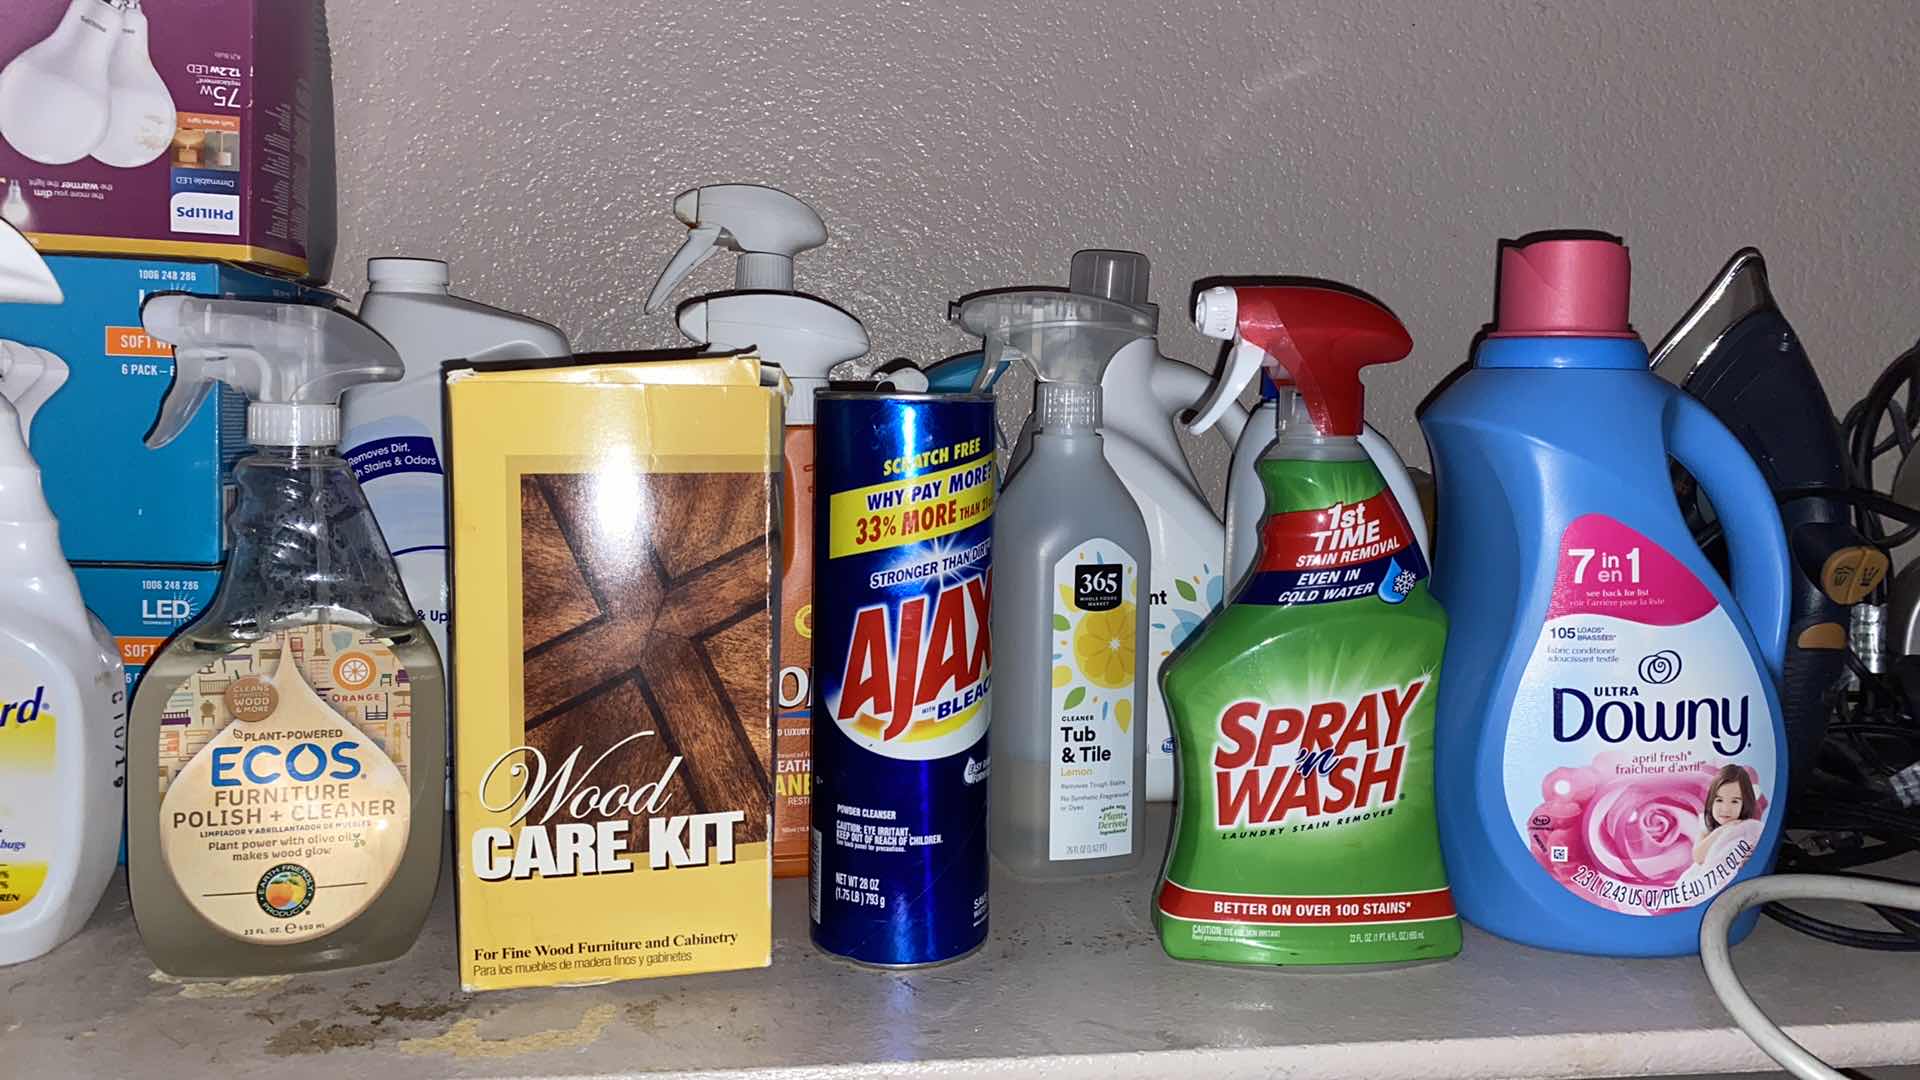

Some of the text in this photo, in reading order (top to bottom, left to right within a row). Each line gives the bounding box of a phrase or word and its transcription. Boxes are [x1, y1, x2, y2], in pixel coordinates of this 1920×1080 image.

[186, 64, 241, 77] 12.2w LED
[200, 85, 241, 108] 75w
[61, 181, 99, 190] warmer
[175, 176, 193, 186] LED
[33, 189, 53, 199] dim
[176, 206, 234, 221] PHILIPS
[139, 269, 160, 280] 1006
[162, 270, 178, 281] 248
[120, 334, 152, 349] SOFT
[130, 364, 158, 376] PACK
[347, 446, 390, 468] Removes
[363, 458, 393, 475] Stains
[394, 456, 403, 466] &
[404, 454, 437, 467] Odors
[883, 437, 981, 477] SCRATCH FREE
[867, 461, 992, 511] WHY PAY MORE?
[855, 499, 980, 545] 33% MORE THAN
[1328, 503, 1366, 530] 1st
[1310, 519, 1380, 552] TIME
[1296, 536, 1400, 568] STAIN REMOVAL
[870, 552, 971, 588] STRONGER THAN
[1568, 547, 1640, 584] 7 in 1
[141, 580, 162, 590] 1006
[164, 580, 180, 590] 248
[1080, 571, 1118, 594] 365
[1297, 568, 1362, 586] EVEN IN
[1598, 570, 1623, 583] en
[1278, 582, 1375, 603] COLD WATER
[1602, 589, 1622, 597] back
[1624, 589, 1636, 597] for
[142, 599, 191, 619] LED
[416, 609, 426, 621] &
[1550, 627, 1576, 639] 105
[123, 644, 158, 658] SOFT
[837, 567, 993, 742] AJAX
[1572, 646, 1617, 655] conditioner
[1596, 655, 1618, 663] textile
[332, 692, 381, 703] ORANGE
[1594, 686, 1639, 697] ULTRA
[233, 697, 270, 706] WOOD
[1061, 714, 1095, 722] CLEANER
[1215, 680, 1425, 769] SPRAY
[1552, 687, 1750, 757] Downy
[244, 729, 343, 742] PLANT-POWERED
[1060, 726, 1097, 743] Tub
[1061, 745, 1112, 763] & Tile
[1632, 752, 1657, 764] april
[211, 741, 362, 787] ECOS
[1060, 767, 1094, 777] Lemon
[478, 730, 683, 828] Wood
[1216, 745, 1406, 826] WASH
[215, 783, 350, 807] FURNITURE
[173, 799, 396, 828] POLISH + CLEANER
[836, 803, 897, 820] POWDER CLEANSER
[864, 825, 876, 835] EYE
[1222, 808, 1394, 840] LAUNDRY STAIN REMOVER
[200, 828, 247, 839] LIMPIADOR
[208, 832, 351, 851] Plant power with olive oil
[836, 829, 851, 841] KEEP
[851, 832, 863, 843] OUT
[864, 835, 873, 844] OF
[874, 836, 898, 846] REACH
[898, 836, 908, 846] OF
[909, 834, 944, 846] CHILDREN.
[232, 847, 333, 862] makes wood glow
[471, 809, 746, 883] CARE KIT
[835, 872, 880, 891] NET WT 28 OZ
[1572, 866, 1593, 887] 2.3
[1599, 881, 1626, 903] (2.43
[1628, 888, 1643, 905] US
[1645, 887, 1681, 910] QT/PTE
[1704, 872, 1718, 889] 77
[1716, 864, 1728, 880] FL
[1726, 855, 1740, 870] OZ
[835, 886, 886, 908] (1.75 793 g
[1214, 901, 1268, 916] BETTER
[1271, 904, 1291, 916] ON
[1296, 904, 1331, 916] OVER
[1335, 903, 1360, 916] 100
[474, 932, 738, 961] For Fine Wood Furniture and Cabinetry
[473, 951, 693, 977] Para los muebles de madera finos y gabinetes
